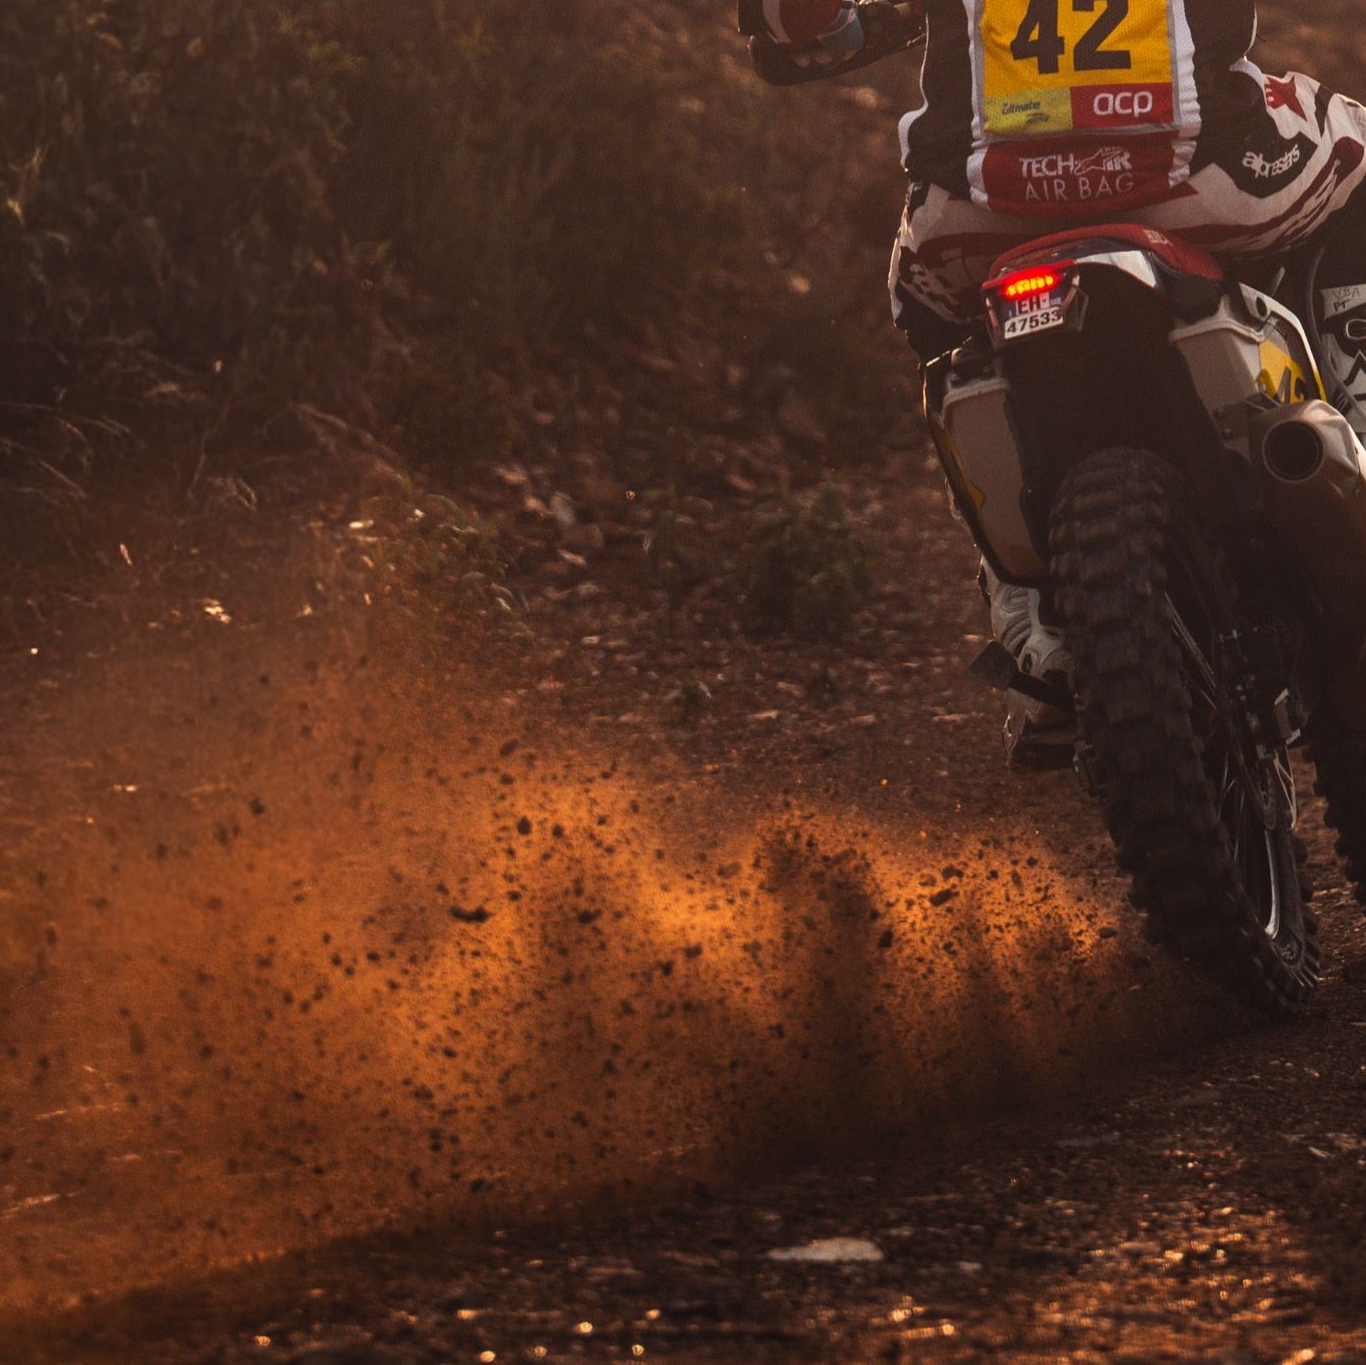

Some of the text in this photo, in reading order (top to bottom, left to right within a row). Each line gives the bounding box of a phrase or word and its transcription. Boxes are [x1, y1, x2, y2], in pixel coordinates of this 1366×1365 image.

[1093, 90, 1153, 117] acp
[1019, 153, 1075, 178] TECH
[1025, 172, 1135, 203] AIR BAG
[1006, 310, 1063, 334] 47533
